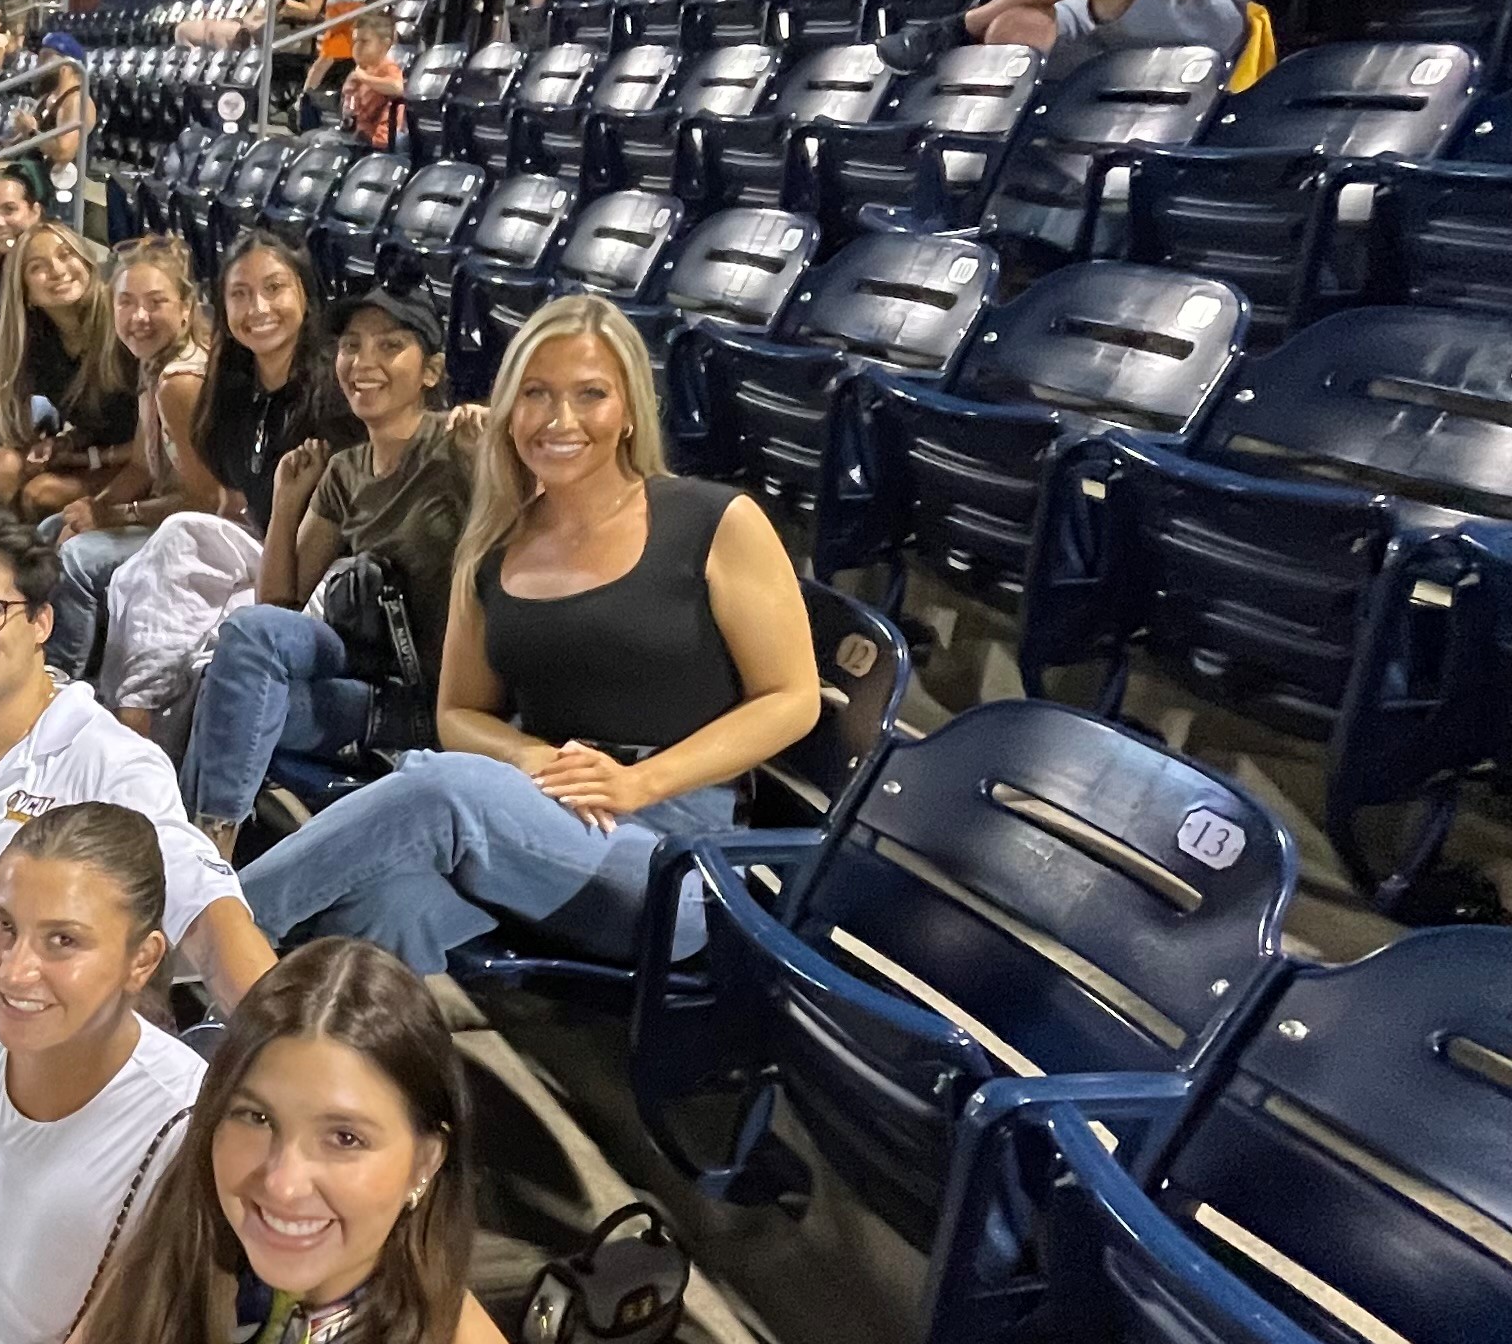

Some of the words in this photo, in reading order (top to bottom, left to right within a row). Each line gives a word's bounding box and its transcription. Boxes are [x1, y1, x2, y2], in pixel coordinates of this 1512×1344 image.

[844, 642, 869, 669] 12
[10, 790, 56, 818] VCU
[1191, 821, 1230, 857] 13
